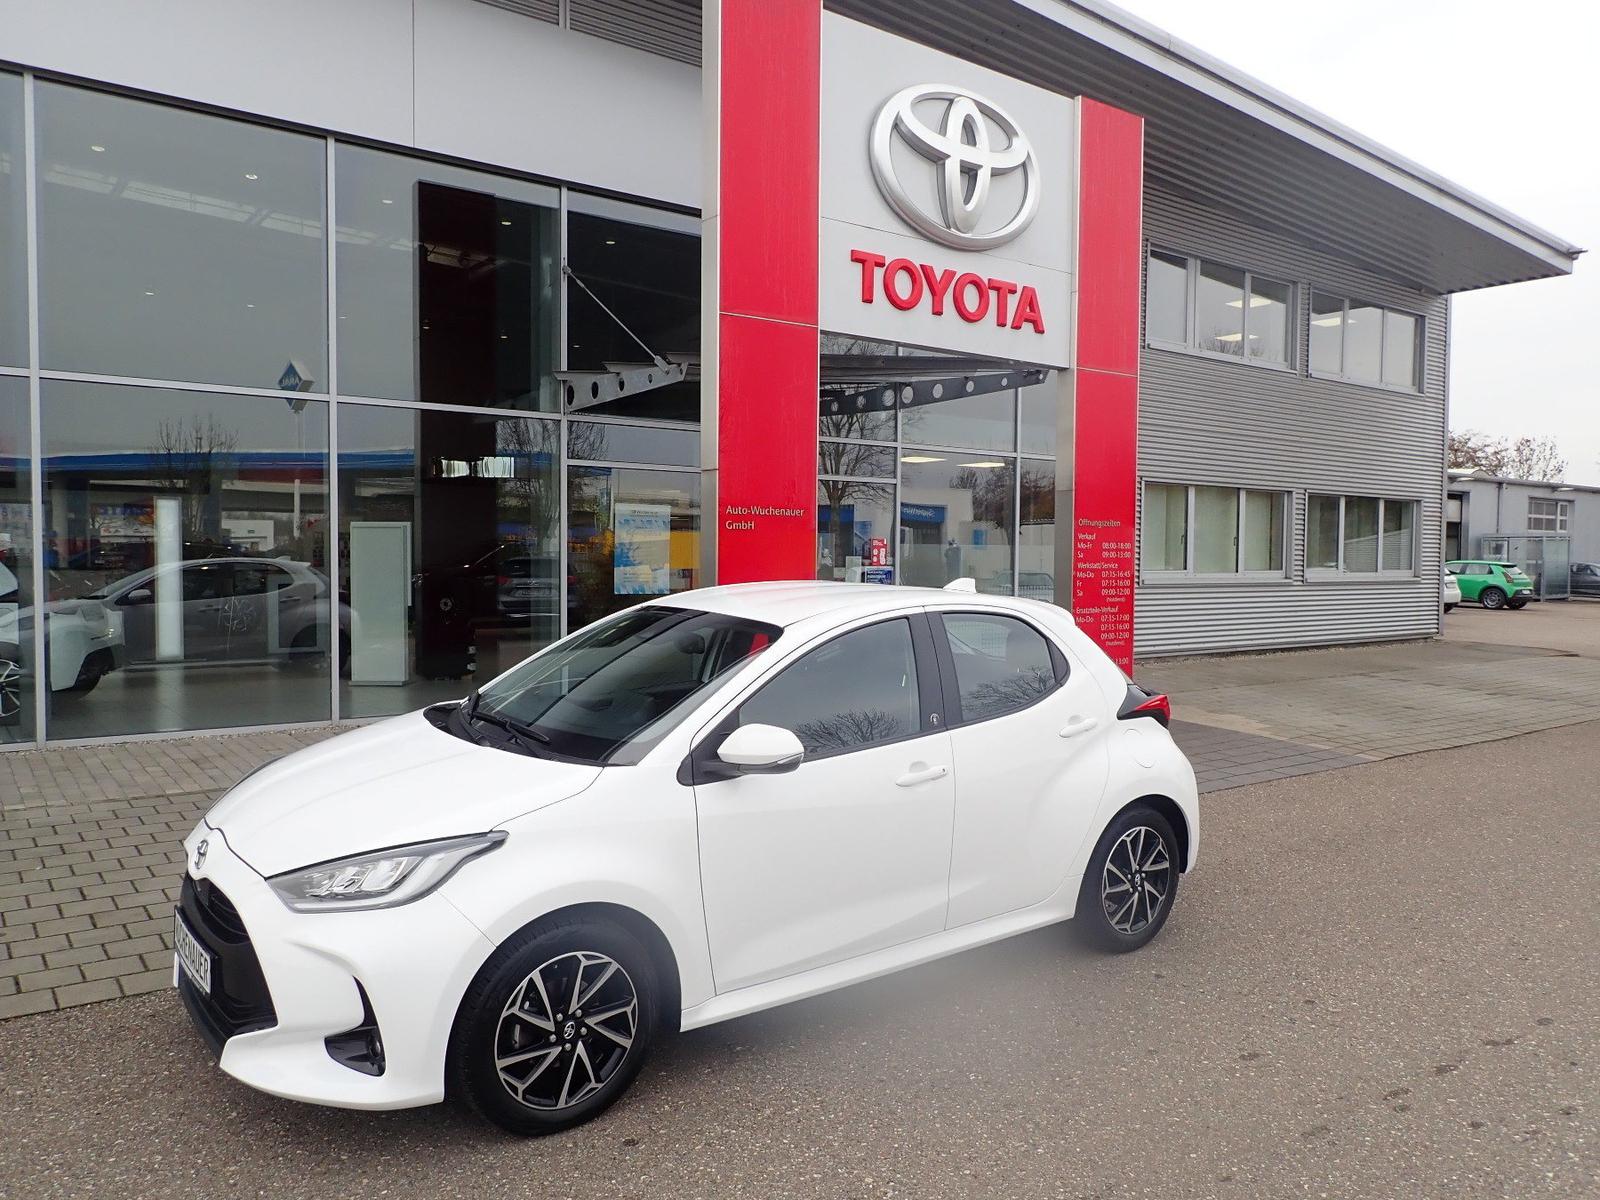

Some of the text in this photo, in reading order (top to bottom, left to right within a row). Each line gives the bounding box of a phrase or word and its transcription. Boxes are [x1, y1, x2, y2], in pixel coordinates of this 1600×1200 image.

[850, 249, 1045, 335] TOYOTA
[725, 505, 804, 517] Auto-Wuchenauer
[725, 520, 755, 530] GmbH
[1078, 518, 1120, 528] Öffnungszeiten
[1077, 532, 1096, 540] Verkauf
[1077, 541, 1093, 549] Mo-Fr
[1101, 570, 1131, 578] 07:15-16:45
[1101, 579, 1131, 587] 07:15-16:00
[1076, 588, 1131, 597] Sa 09:00-12:00
[1075, 615, 1094, 623] Mo-Do
[1100, 623, 1130, 631] 07:15-16:00
